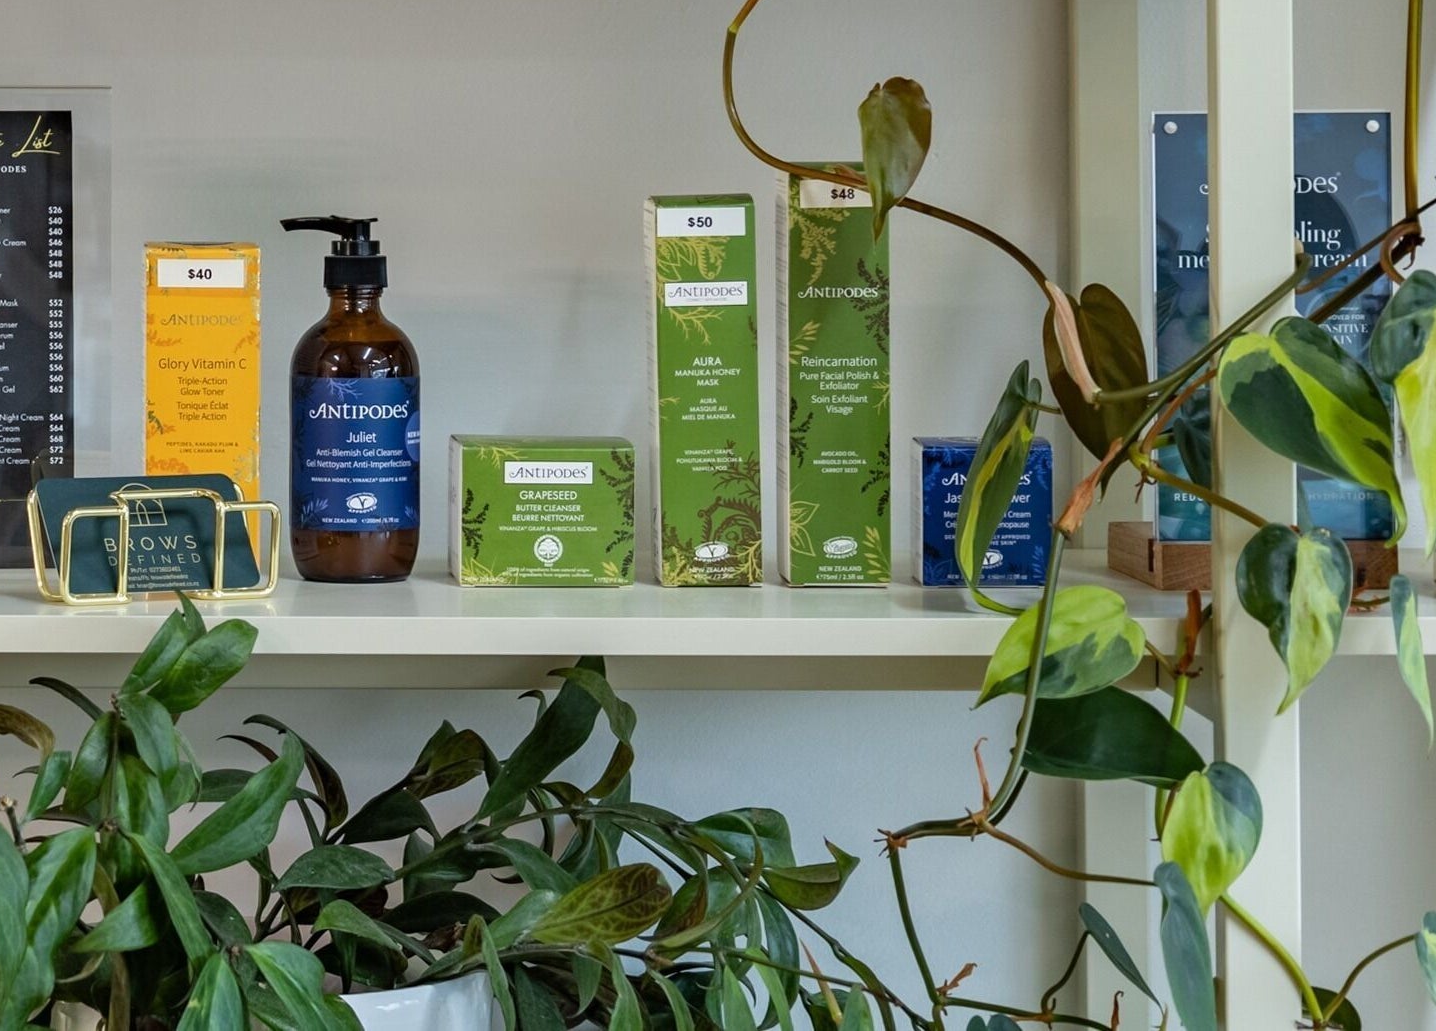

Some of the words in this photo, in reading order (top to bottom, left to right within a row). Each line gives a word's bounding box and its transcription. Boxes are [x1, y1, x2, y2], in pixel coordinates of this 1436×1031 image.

[12, 115, 61, 158] List
[831, 189, 855, 200] $48
[48, 206, 63, 214] $26
[48, 217, 63, 225] $40
[688, 217, 712, 228] $50
[49, 228, 63, 236] $40
[2, 238, 27, 247] Cream
[49, 239, 63, 247] $46
[49, 249, 63, 257] $48
[49, 260, 63, 268] $48
[49, 271, 63, 279] $48
[188, 269, 212, 280] $40
[158, 358, 188, 372] Glory
[192, 358, 236, 370] Vitamin
[239, 358, 247, 370] C
[693, 357, 722, 366] AURA
[801, 356, 877, 367] Reincarnation
[674, 369, 711, 377] MANUKA
[712, 368, 741, 376] HONEY
[799, 372, 819, 380] Pure
[820, 372, 844, 380] Facial
[846, 372, 872, 380] Polish
[178, 376, 227, 387] Triple-Action
[697, 379, 719, 387] MASK
[820, 381, 859, 390] Exfoliator
[180, 388, 200, 396] Glow
[202, 388, 225, 396] Toner
[811, 395, 830, 404] Soin
[832, 395, 868, 404] Exfoliant
[177, 401, 208, 411] Tonique
[210, 400, 229, 409] Éclat
[826, 405, 853, 415] Visage
[179, 412, 200, 422] Triple
[202, 412, 227, 421] Action
[346, 431, 377, 443] Juliet
[316, 448, 361, 457] Anti-Blemish
[363, 449, 375, 457] Gel
[376, 448, 403, 456] Cleanser
[306, 459, 316, 467] Gel
[317, 460, 352, 469] Nettoyant
[353, 460, 411, 469] Anti-Imperfections
[520, 491, 577, 500] GRAPESEED
[104, 535, 197, 552] BROWS
